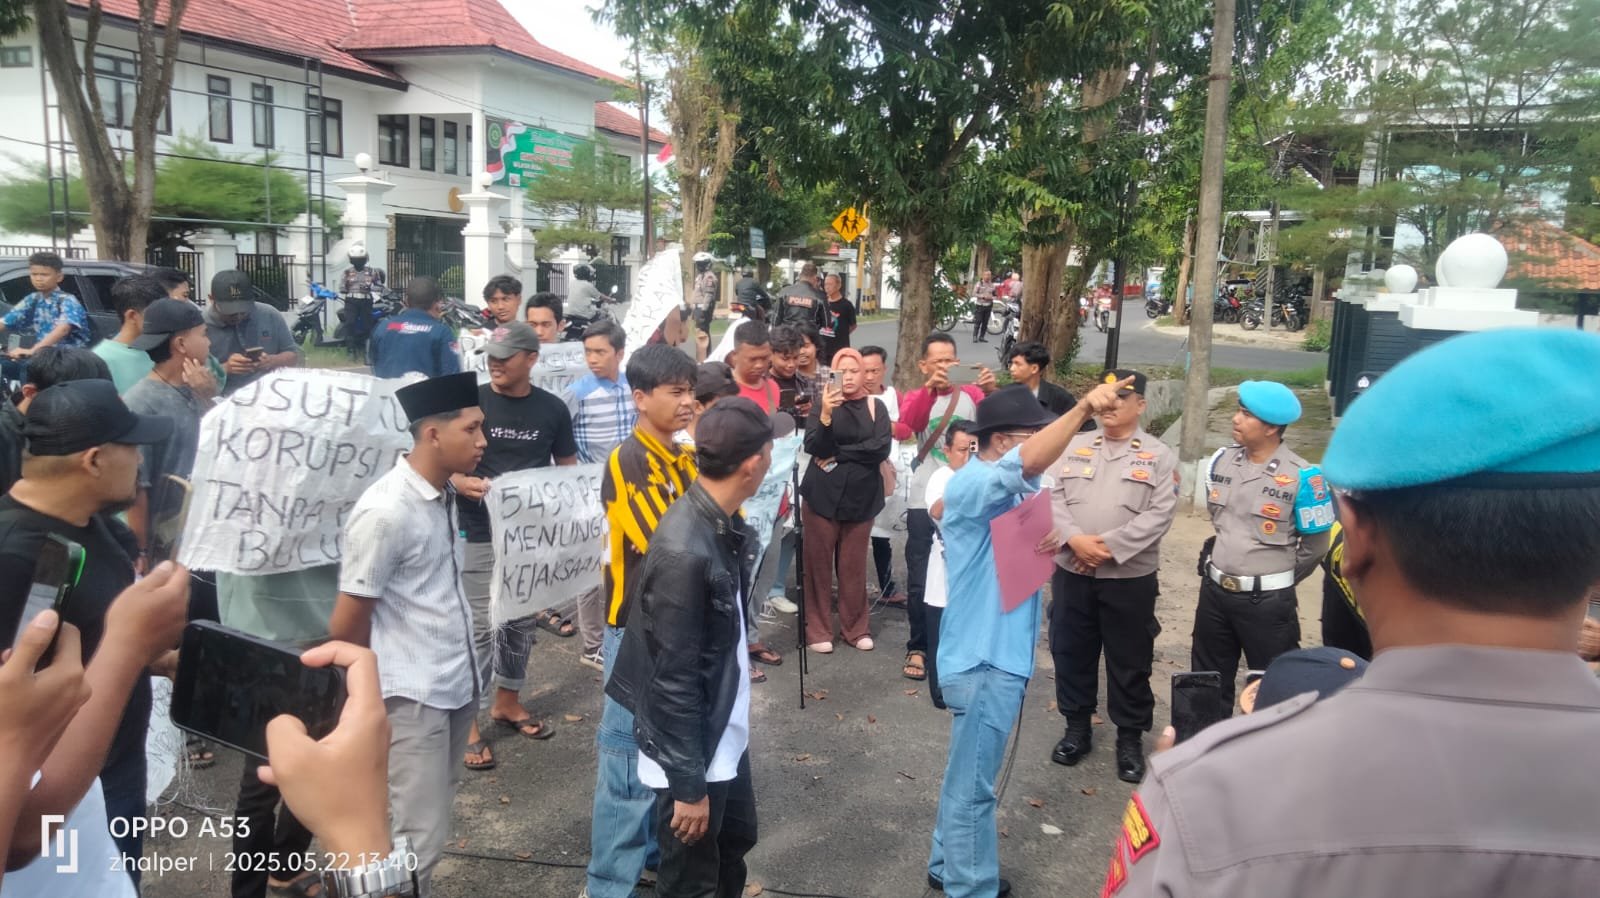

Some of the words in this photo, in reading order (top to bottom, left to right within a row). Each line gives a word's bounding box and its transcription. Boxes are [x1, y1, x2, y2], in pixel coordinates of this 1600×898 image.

[213, 419, 382, 478] KORUPSI
[205, 479, 323, 529] TANPA
[1262, 486, 1293, 501] POLRI
[503, 514, 604, 556] MENUNG
